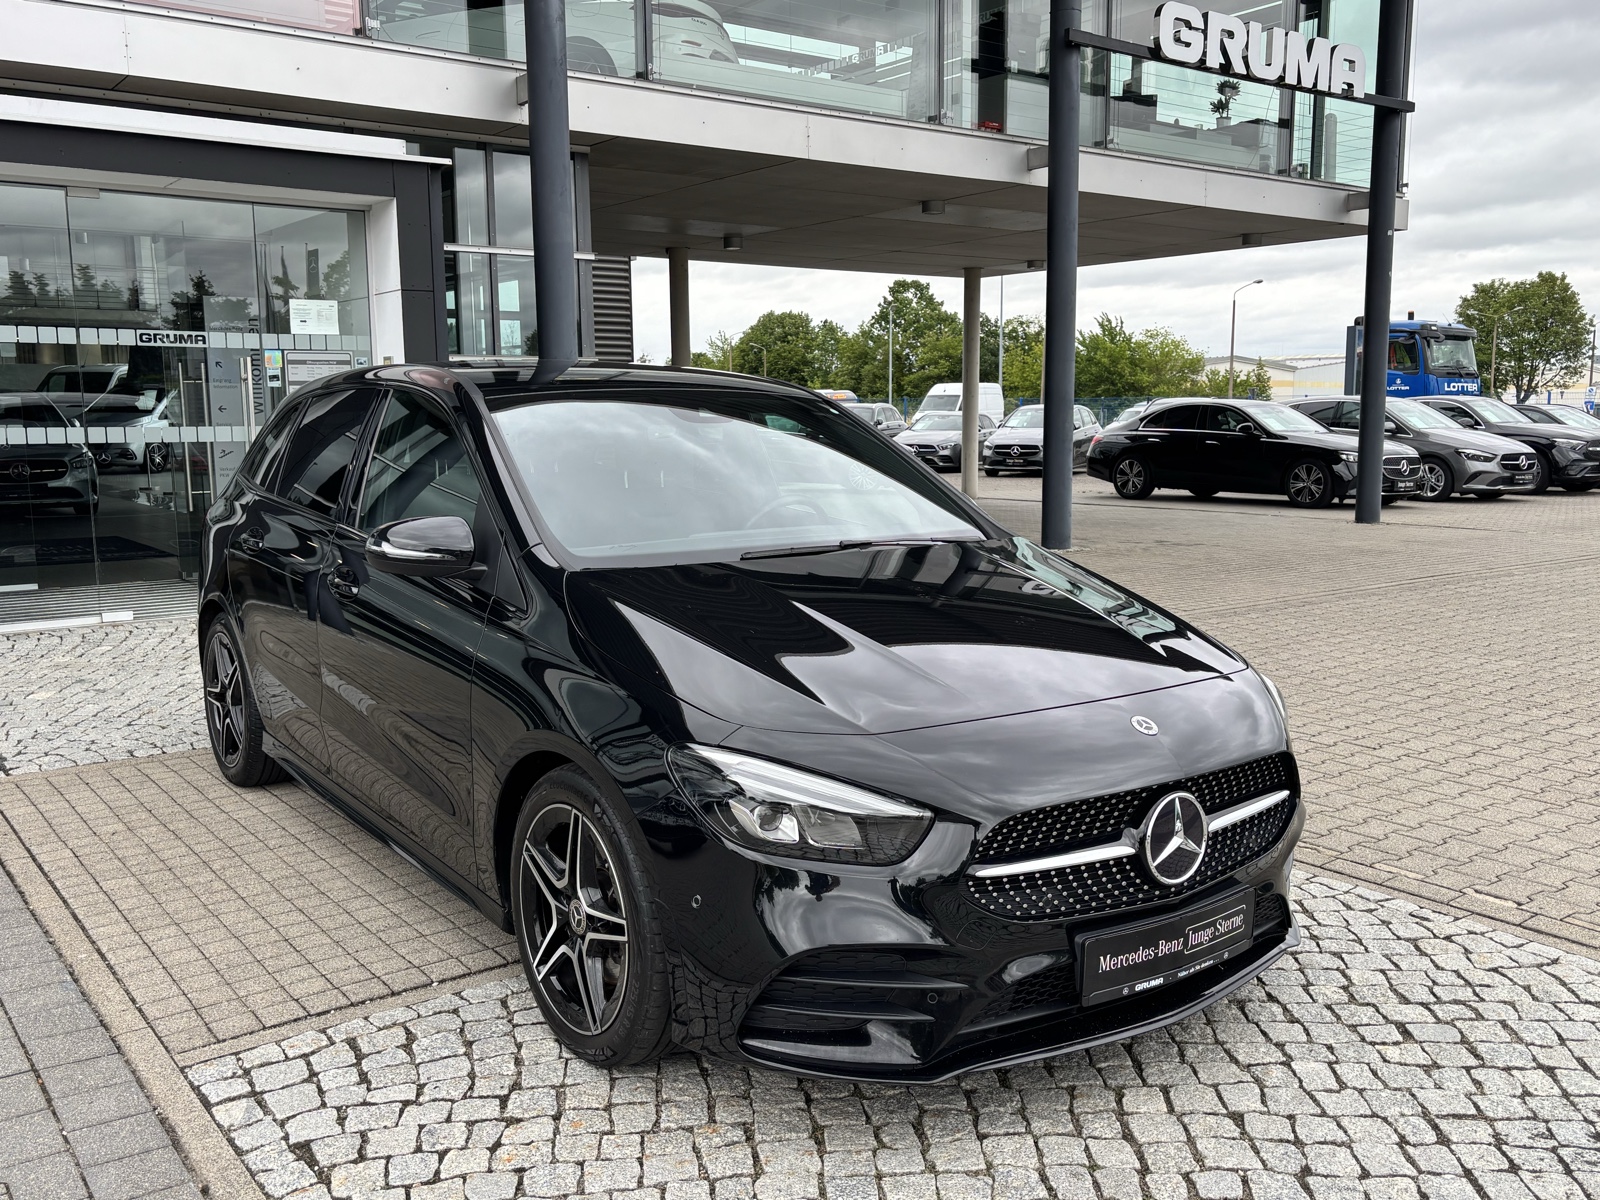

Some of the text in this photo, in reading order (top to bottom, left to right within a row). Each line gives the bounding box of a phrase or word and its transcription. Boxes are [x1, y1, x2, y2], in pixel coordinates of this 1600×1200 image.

[851, 46, 883, 64] GRUMA
[1154, 1, 1366, 98] GRUMA
[139, 332, 206, 345] GRUMA
[248, 318, 264, 415] Willkomen
[1444, 382, 1478, 391] LOTTER
[1098, 913, 1244, 973] Mercedes-Benz Junge Sterne
[1135, 977, 1163, 991] GRUMA
